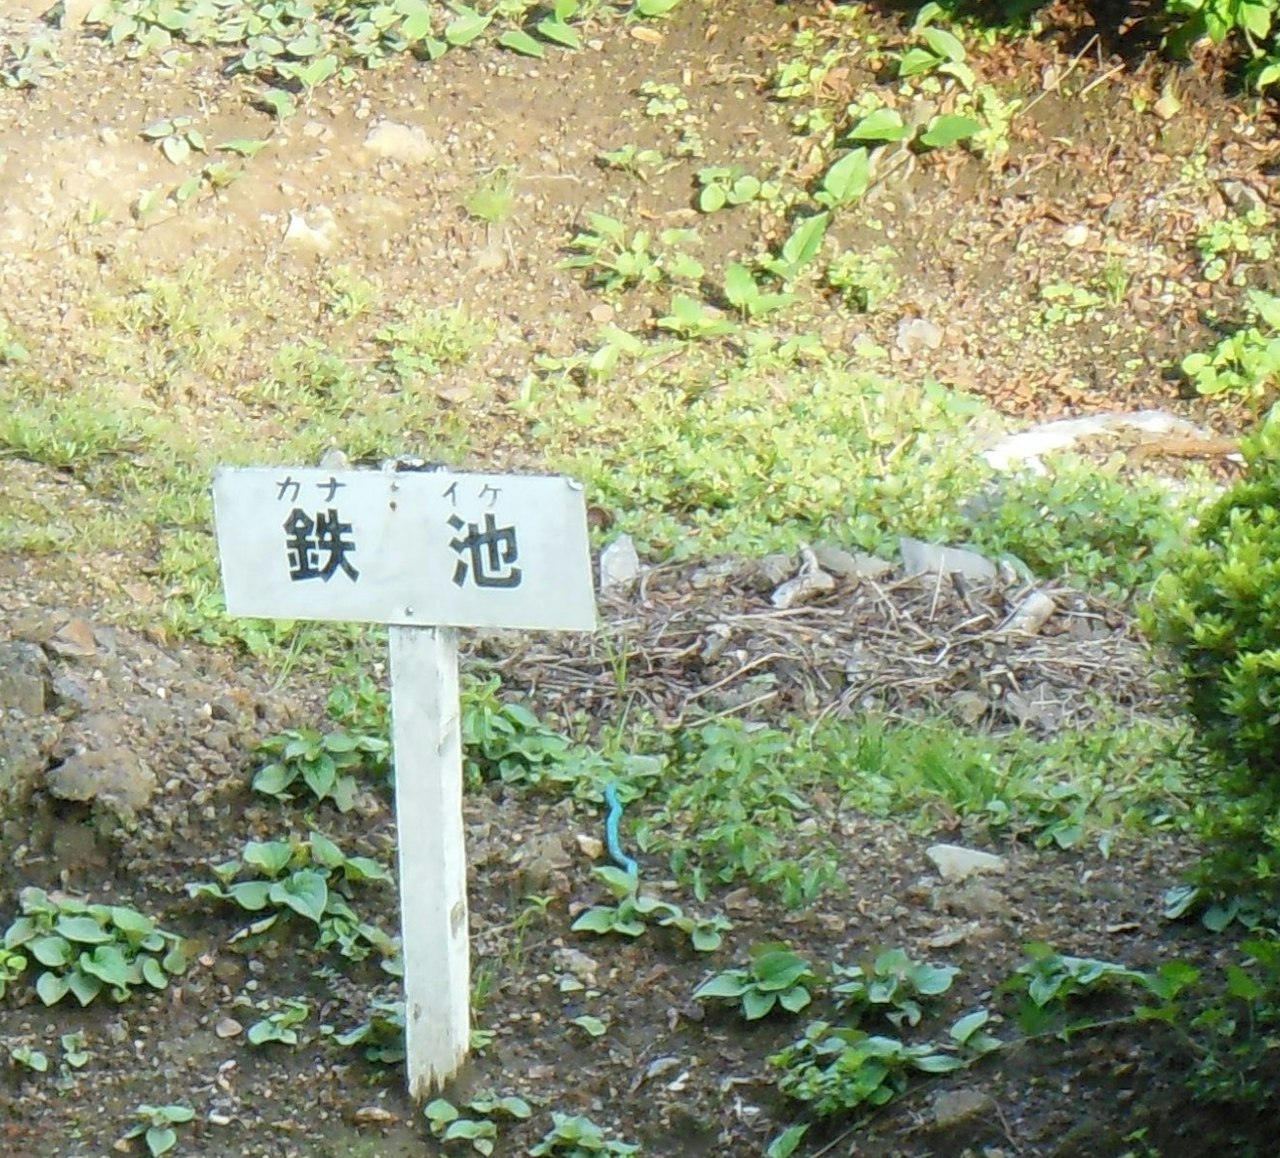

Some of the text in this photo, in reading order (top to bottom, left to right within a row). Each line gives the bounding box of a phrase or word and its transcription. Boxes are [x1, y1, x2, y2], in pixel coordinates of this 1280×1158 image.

[276, 476, 503, 507] カナ イケ
[282, 508, 523, 588] 鉄 池
